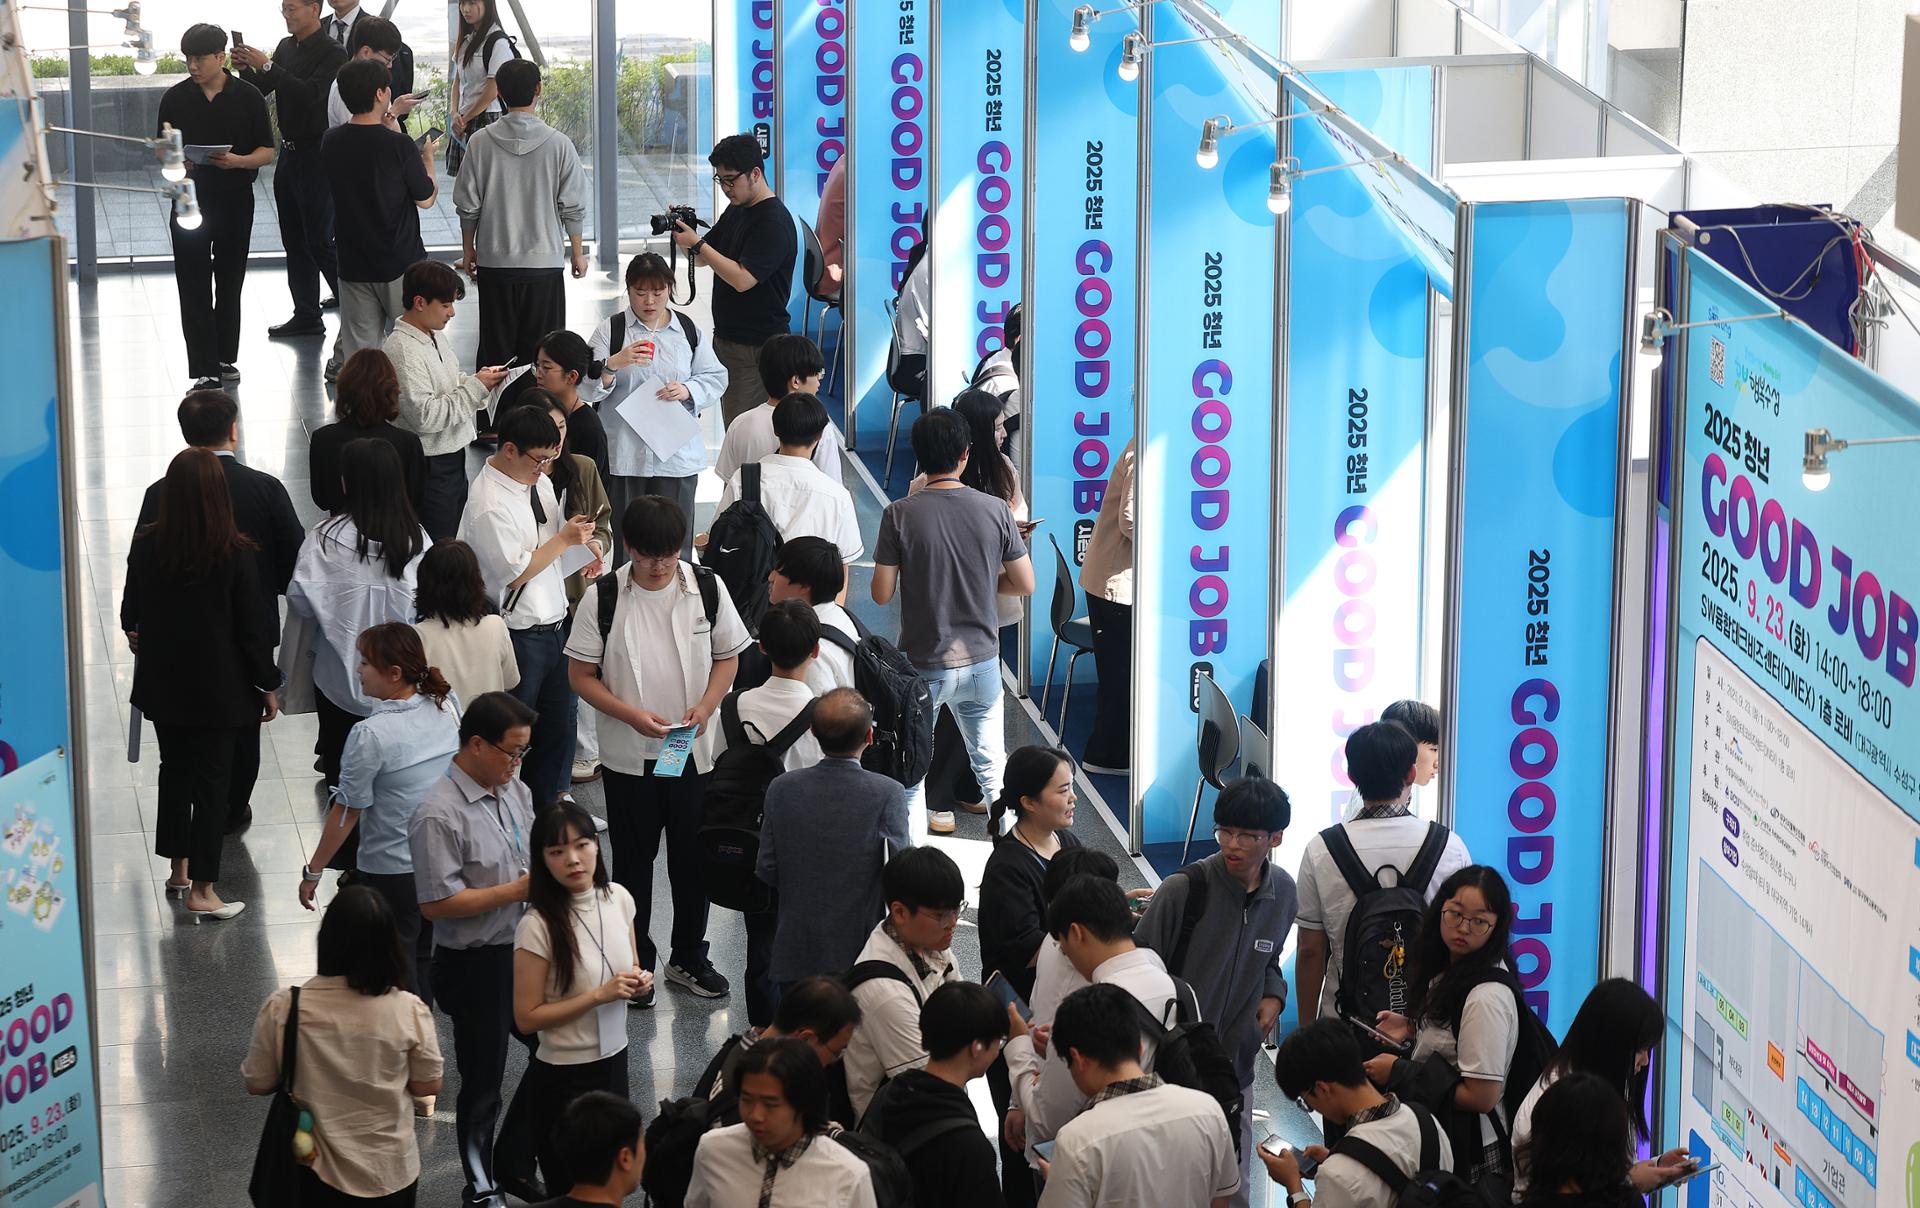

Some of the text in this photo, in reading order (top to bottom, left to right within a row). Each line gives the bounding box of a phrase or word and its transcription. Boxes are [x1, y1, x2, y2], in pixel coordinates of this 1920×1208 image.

[815, 0, 845, 106] OOD
[899, 15, 914, 45] 청년
[986, 49, 1001, 96] 2025
[891, 53, 923, 190] GOOD
[985, 100, 1002, 132] 청년
[1086, 140, 1103, 191] 2025
[977, 141, 1012, 288] GOOD
[1085, 196, 1104, 230] 청년
[1204, 252, 1223, 308] 2025
[1075, 239, 1113, 399] GOOD
[1203, 312, 1223, 349] 청년
[1190, 358, 1233, 531] GOOD
[1347, 387, 1369, 448] 2025
[1704, 402, 1770, 484] 2025 청년
[1073, 411, 1110, 514] JOB
[1346, 453, 1368, 494] 청년
[1189, 545, 1229, 656] JOB
[1332, 504, 1379, 693] GOOD
[1526, 548, 1551, 616] 2025
[1701, 452, 1919, 689] GOOD JOB
[1524, 621, 1550, 667] 청년
[1701, 541, 1743, 608] 2025.
[1747, 579, 1761, 625] 9.
[1815, 641, 1892, 730] 14:00~18:00
[1818, 694, 1833, 727] 1층
[1834, 706, 1854, 745] 로비
[1893, 763, 1916, 796] 수성구
[1507, 678, 1561, 885] GOOD
[0, 992, 73, 1064] OOD
[0, 1052, 48, 1112] OB
[1811, 1101, 1819, 1119] 13
[1823, 1159, 1846, 1198] 기업관
